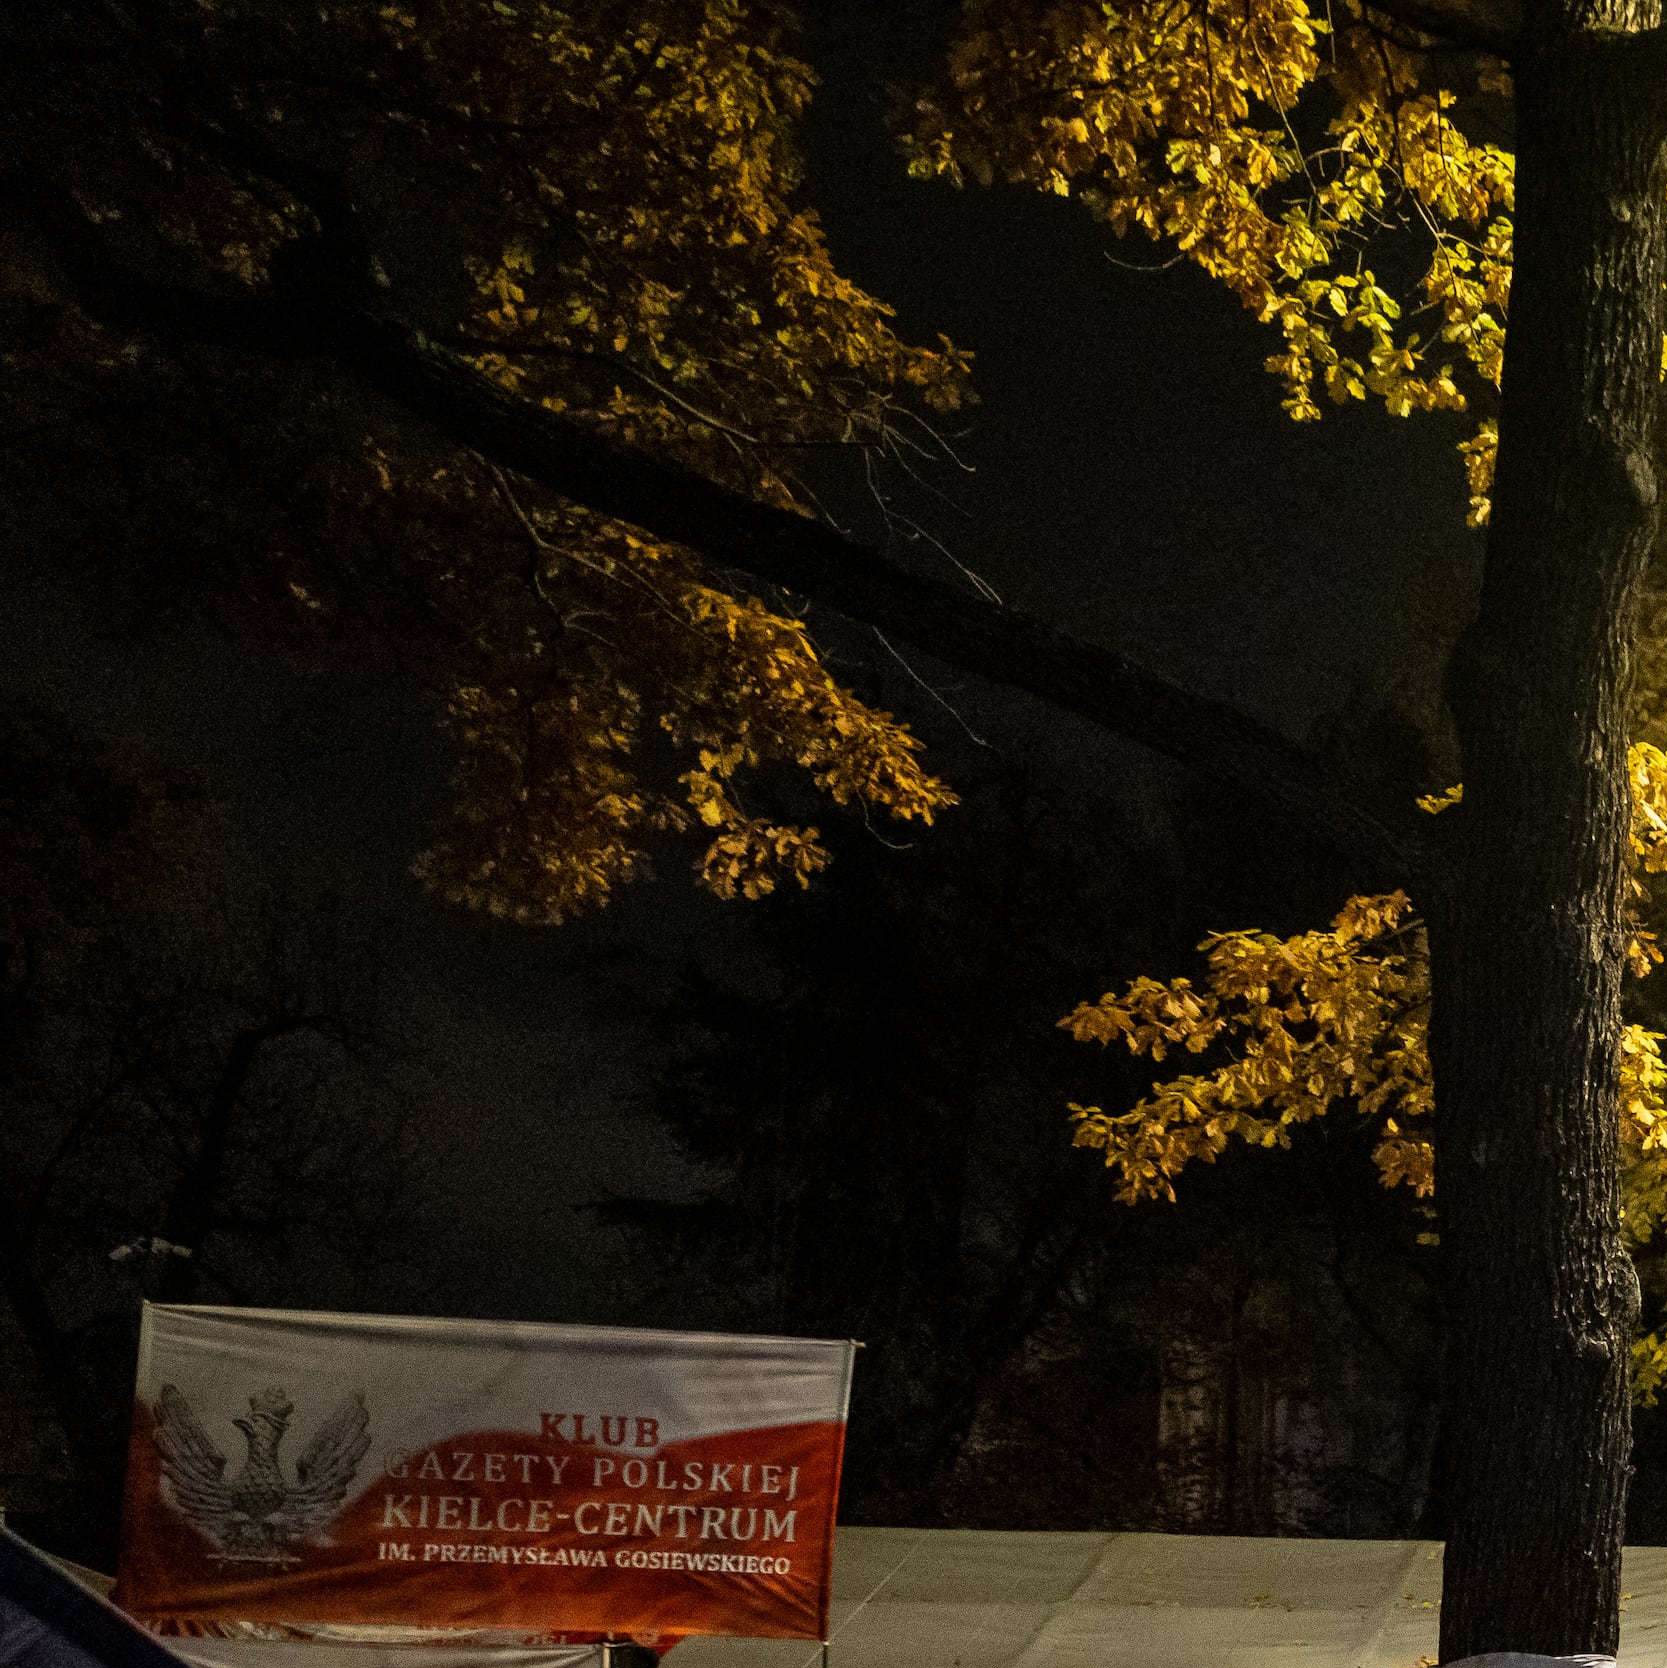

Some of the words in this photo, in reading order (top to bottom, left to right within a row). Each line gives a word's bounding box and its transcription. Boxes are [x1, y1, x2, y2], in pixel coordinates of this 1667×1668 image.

[540, 1412, 660, 1448] KLUB
[385, 1452, 572, 1487] GAZETY
[593, 1456, 800, 1501] POLSKIEJ
[381, 1493, 798, 1543] KIELCE-CENTRUM
[378, 1542, 416, 1562] IM.
[423, 1543, 608, 1569] PRZEMYSŁAWA
[614, 1551, 791, 1575] GOSIEWSKIEGO
